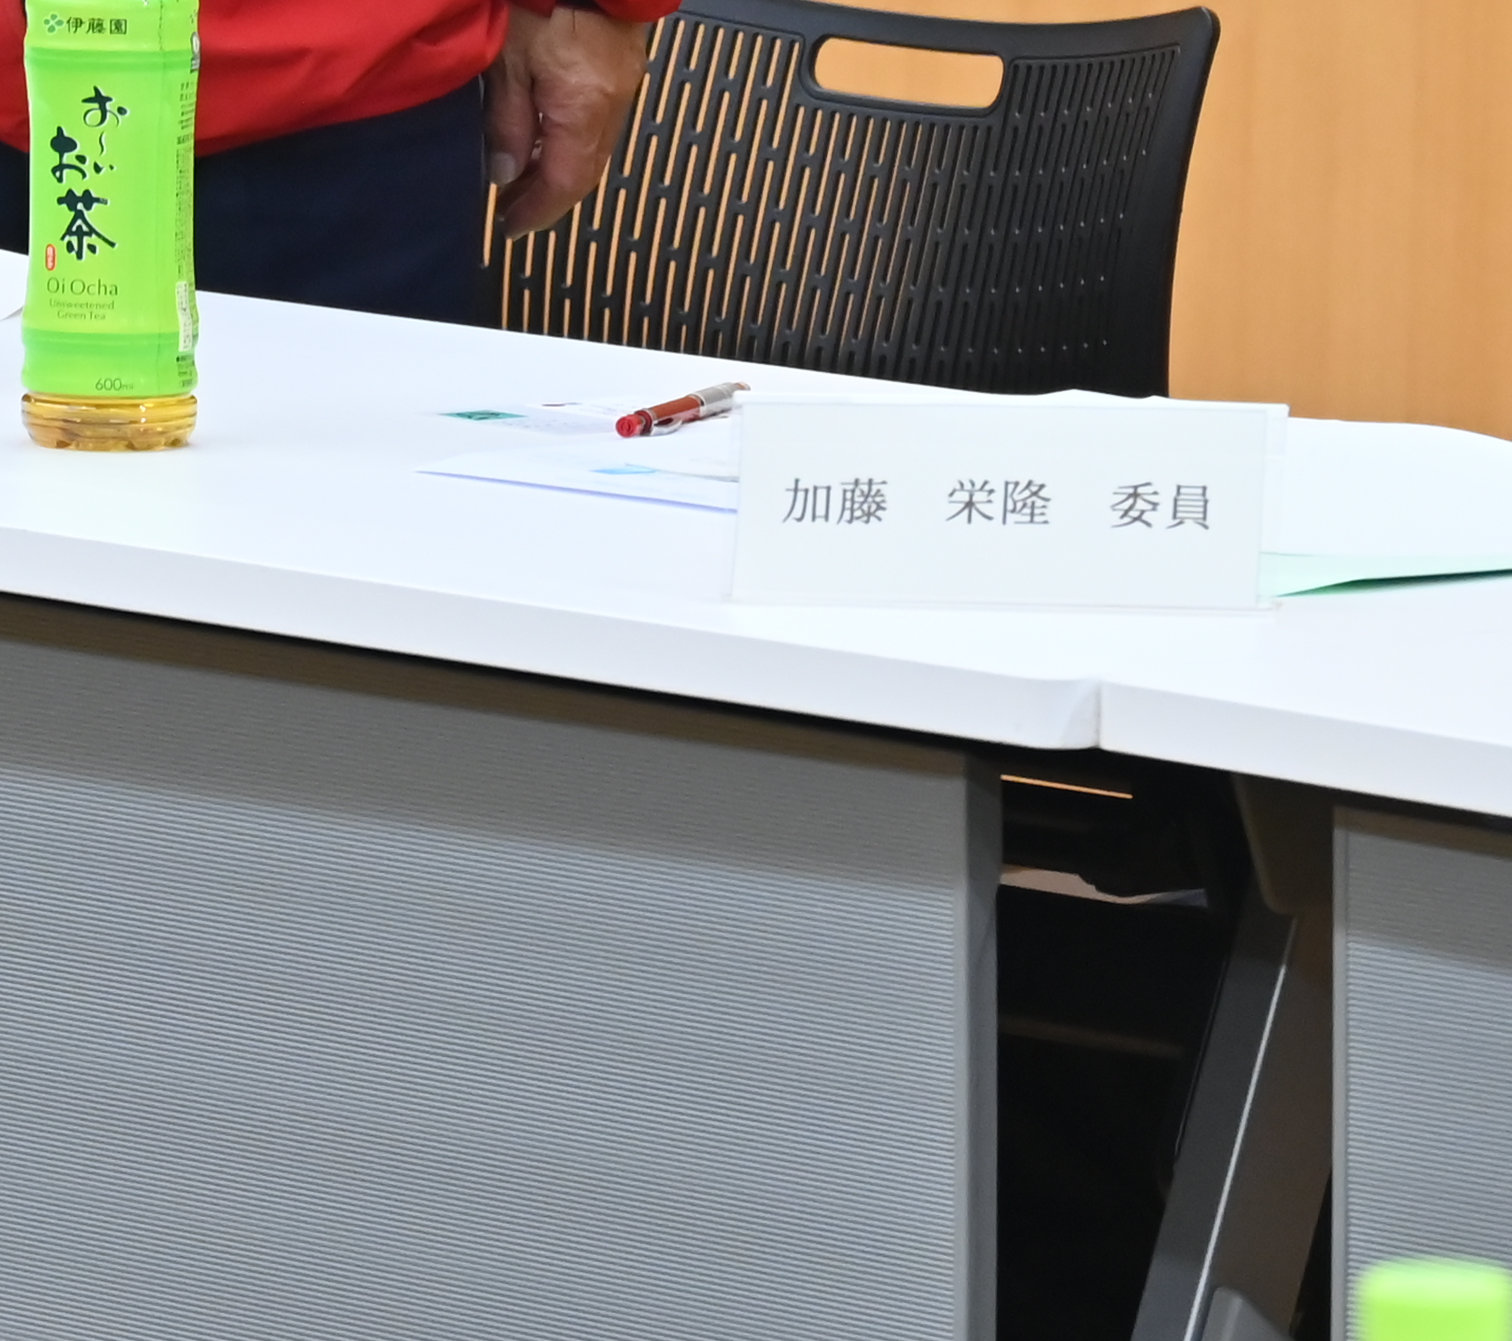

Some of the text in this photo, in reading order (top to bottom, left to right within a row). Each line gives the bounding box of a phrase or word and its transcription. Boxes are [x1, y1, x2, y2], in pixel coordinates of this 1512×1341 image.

[67, 16, 128, 35] 伊藤園
[47, 277, 118, 297] Oi Ocha
[49, 298, 115, 311] Unsweetened
[57, 310, 106, 321] Green Tea
[782, 477, 1211, 531] 加藤 栄隆 委員
